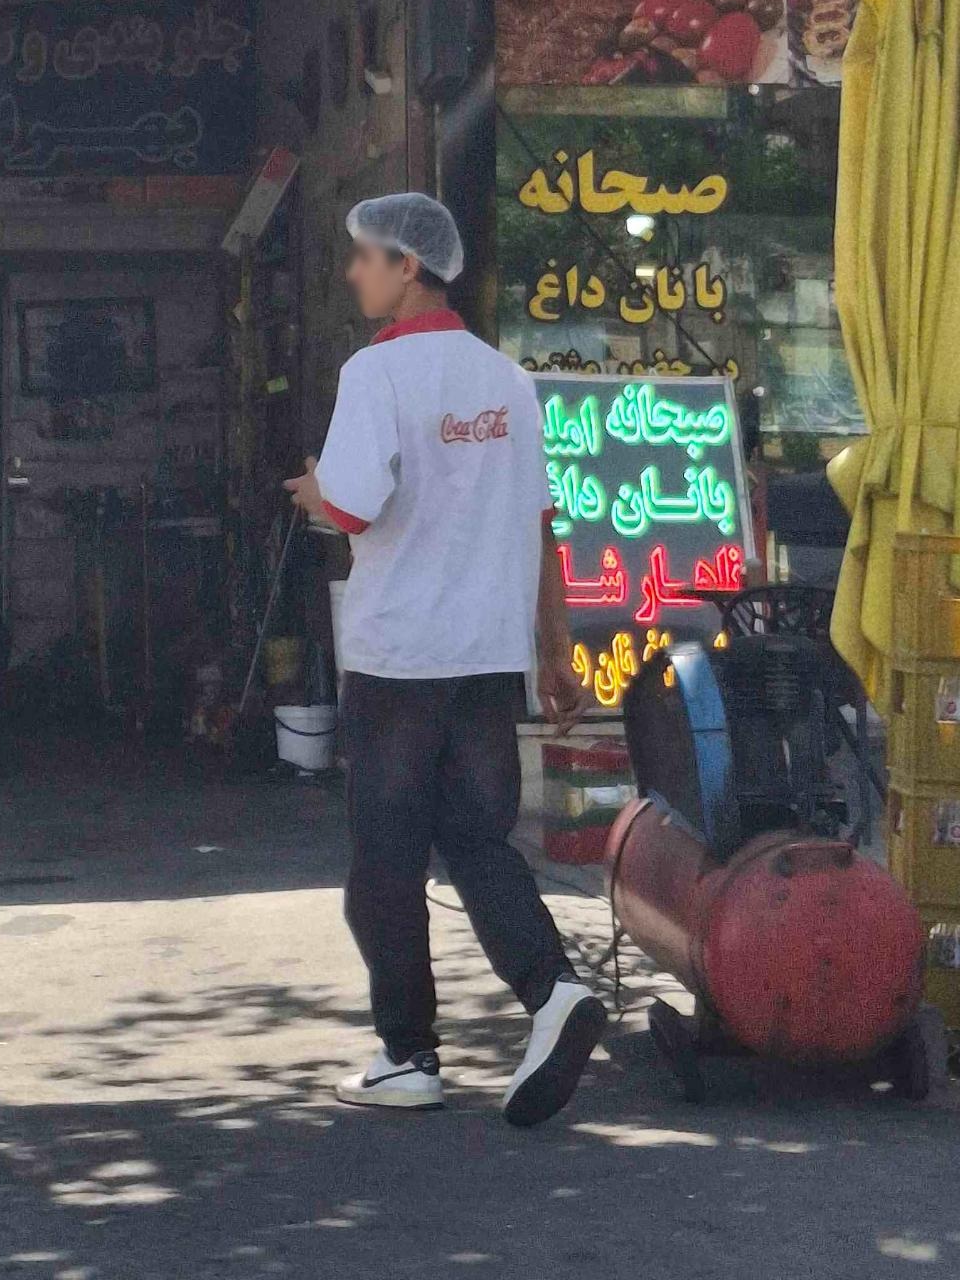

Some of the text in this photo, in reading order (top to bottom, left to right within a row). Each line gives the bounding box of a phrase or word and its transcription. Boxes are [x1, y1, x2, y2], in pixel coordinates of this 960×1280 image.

[518, 148, 728, 243] صبحانه
[527, 258, 606, 320] داغ
[605, 382, 732, 460] صبحانه
